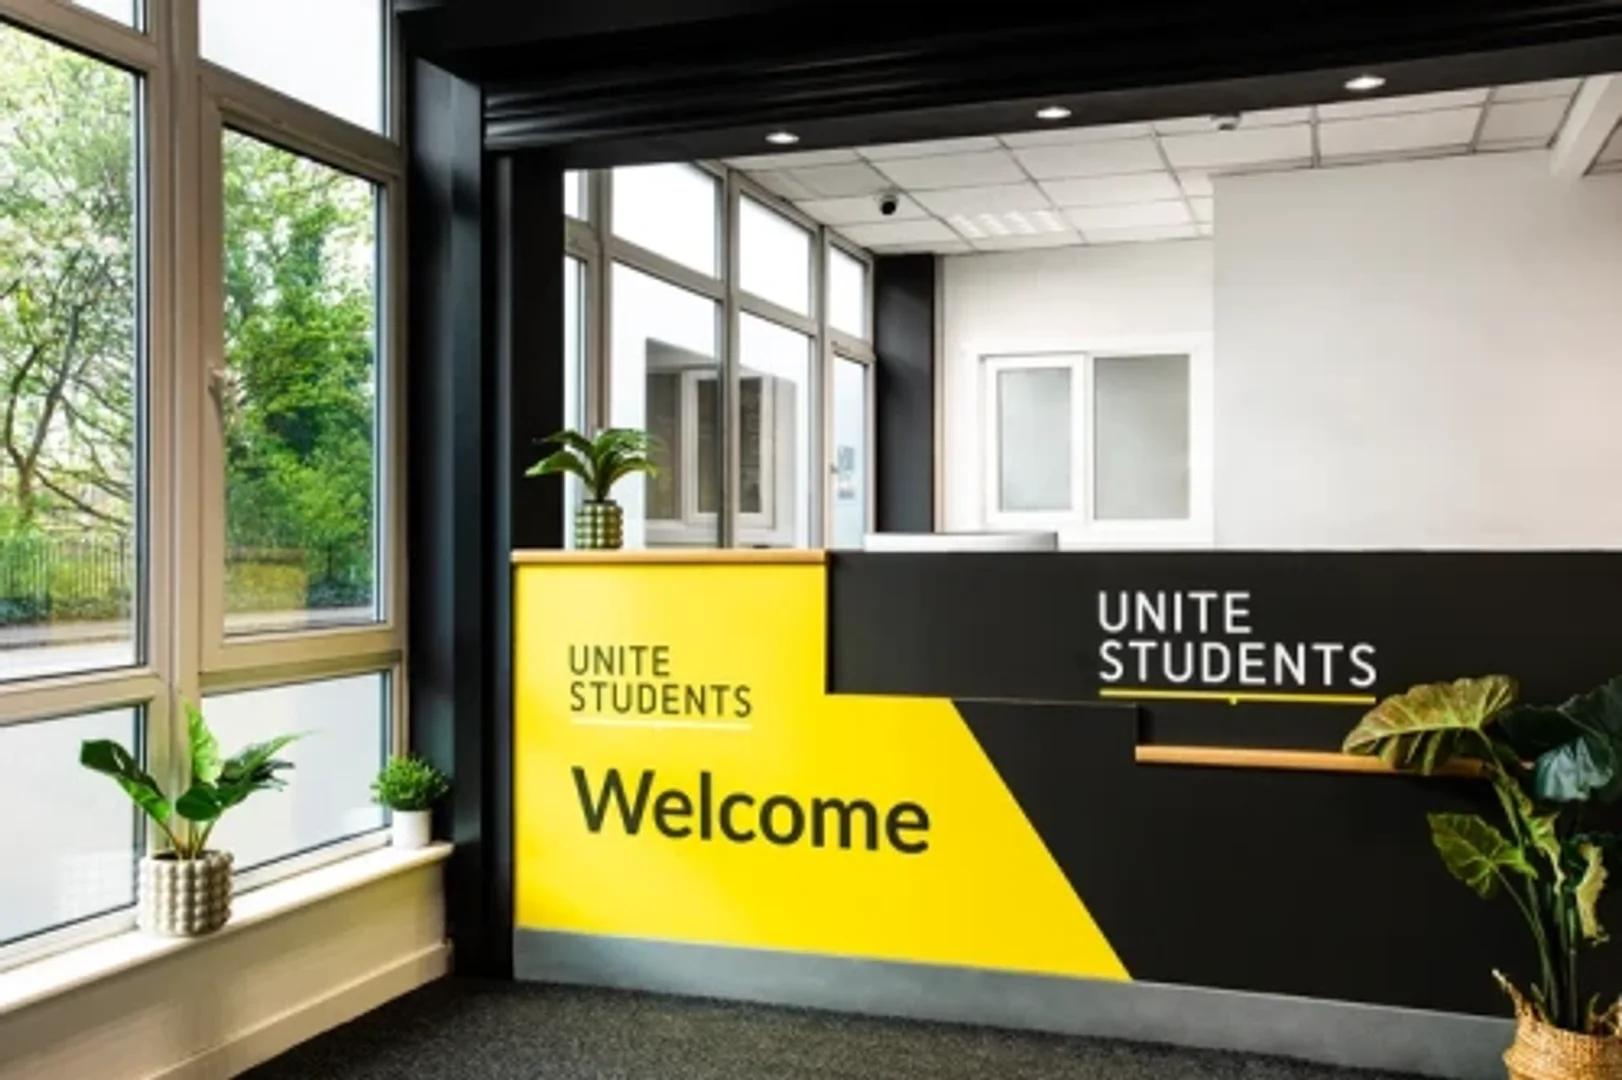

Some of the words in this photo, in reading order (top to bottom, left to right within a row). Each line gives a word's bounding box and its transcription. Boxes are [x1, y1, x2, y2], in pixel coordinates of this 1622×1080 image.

[1098, 590, 1252, 634] UNITE
[569, 644, 671, 677] UNITE
[1098, 639, 1377, 688] STUDENTS
[570, 681, 752, 718] STUDENTS
[571, 765, 931, 855] Welcome
